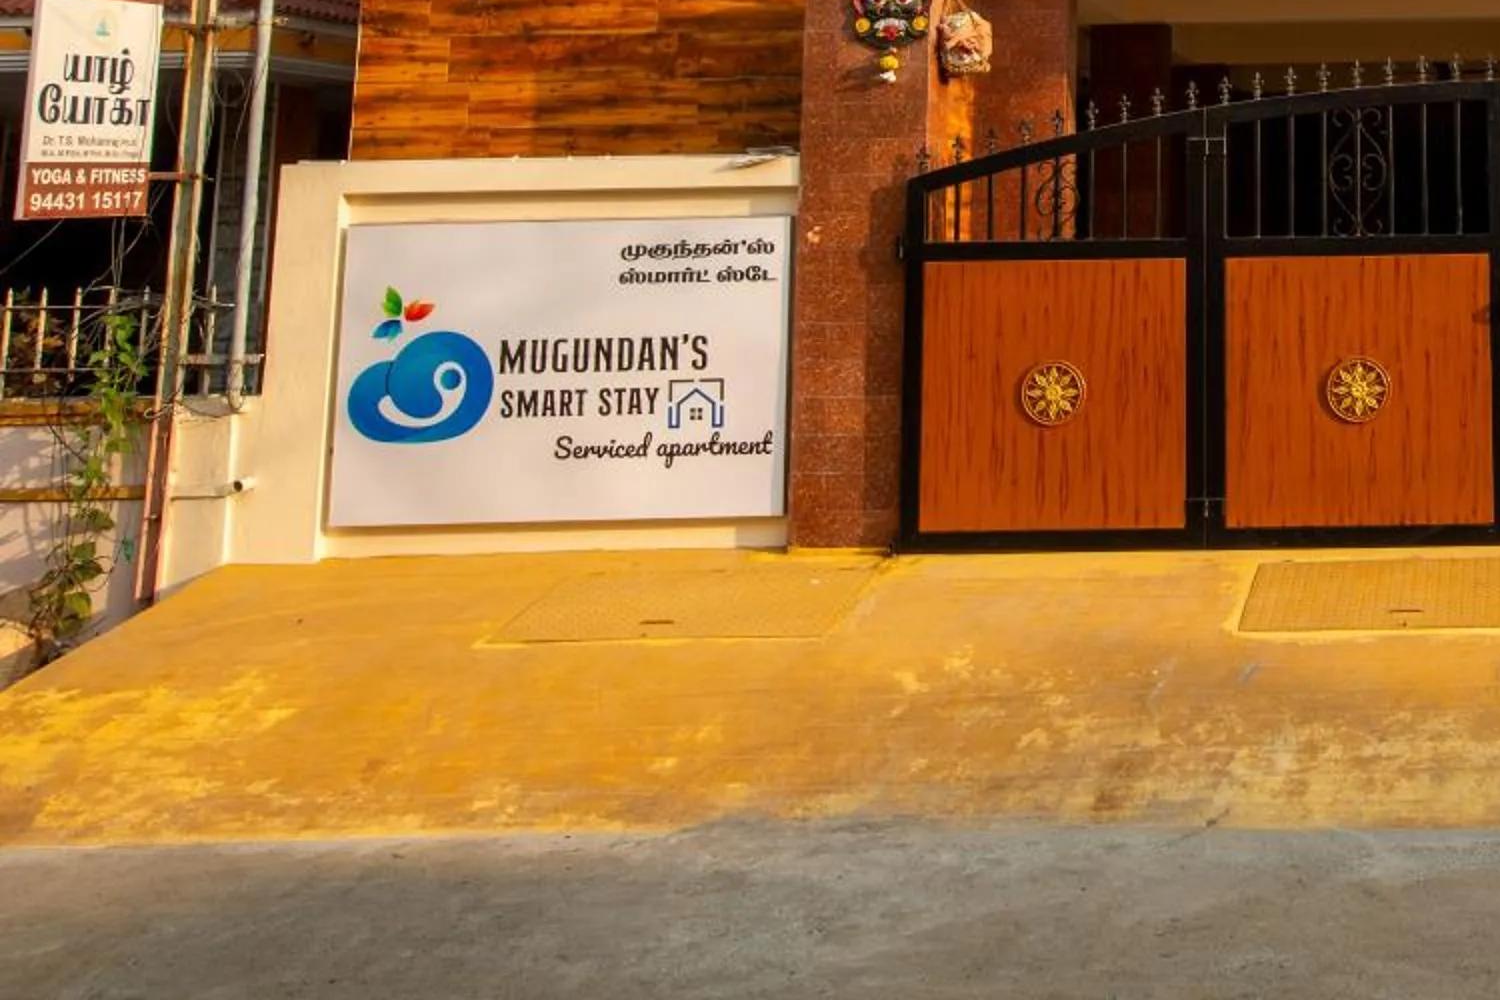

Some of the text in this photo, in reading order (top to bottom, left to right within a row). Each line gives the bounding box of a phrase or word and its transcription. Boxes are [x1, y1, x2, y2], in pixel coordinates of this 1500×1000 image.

[64, 48, 134, 94] யாழ்
[38, 83, 151, 126] யோகா
[31, 168, 146, 185] YOGA & FITNESS
[30, 190, 144, 211] 94431 15117
[716, 265, 778, 282] ஸ்டே
[499, 334, 708, 374] MUGUNDAN'S
[501, 387, 660, 418] SMART STAY
[554, 430, 774, 469] Serviced apartment
